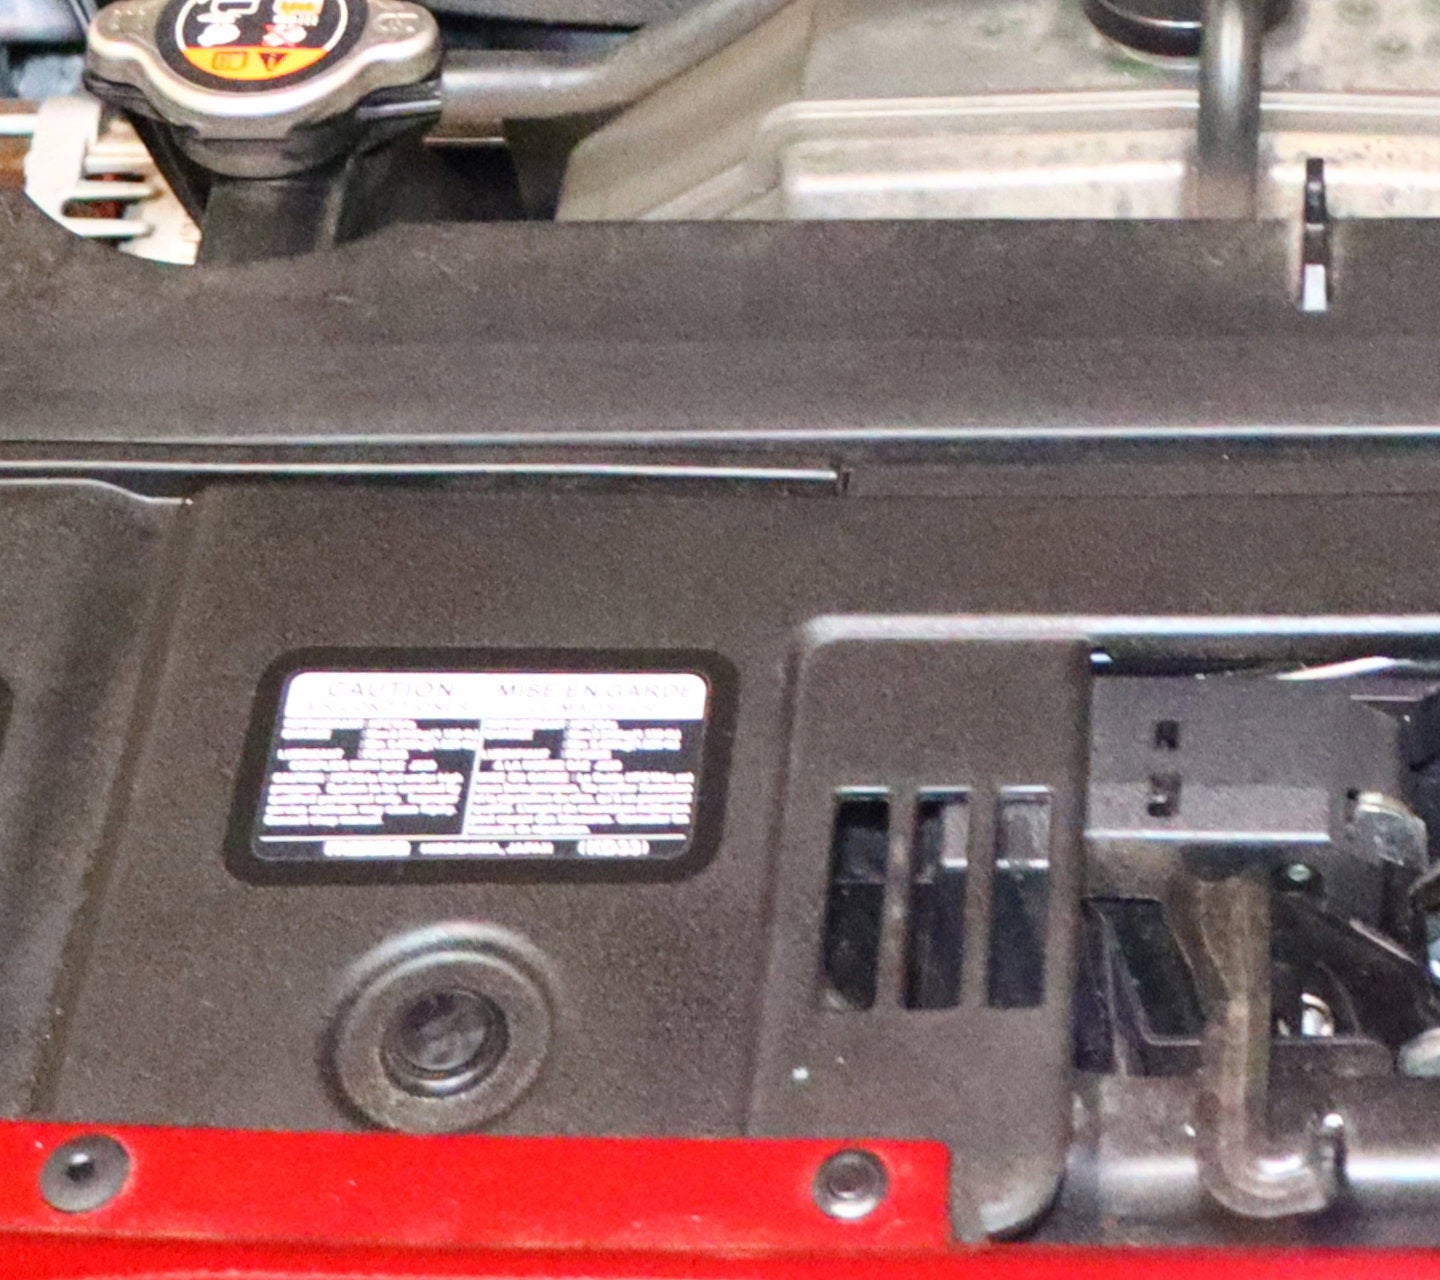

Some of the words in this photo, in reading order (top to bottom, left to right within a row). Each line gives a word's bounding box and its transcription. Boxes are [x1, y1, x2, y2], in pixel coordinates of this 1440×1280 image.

[328, 681, 453, 697] CAUTION
[498, 684, 553, 698] MISE
[566, 684, 598, 698] EN
[606, 684, 690, 698] GARDE
